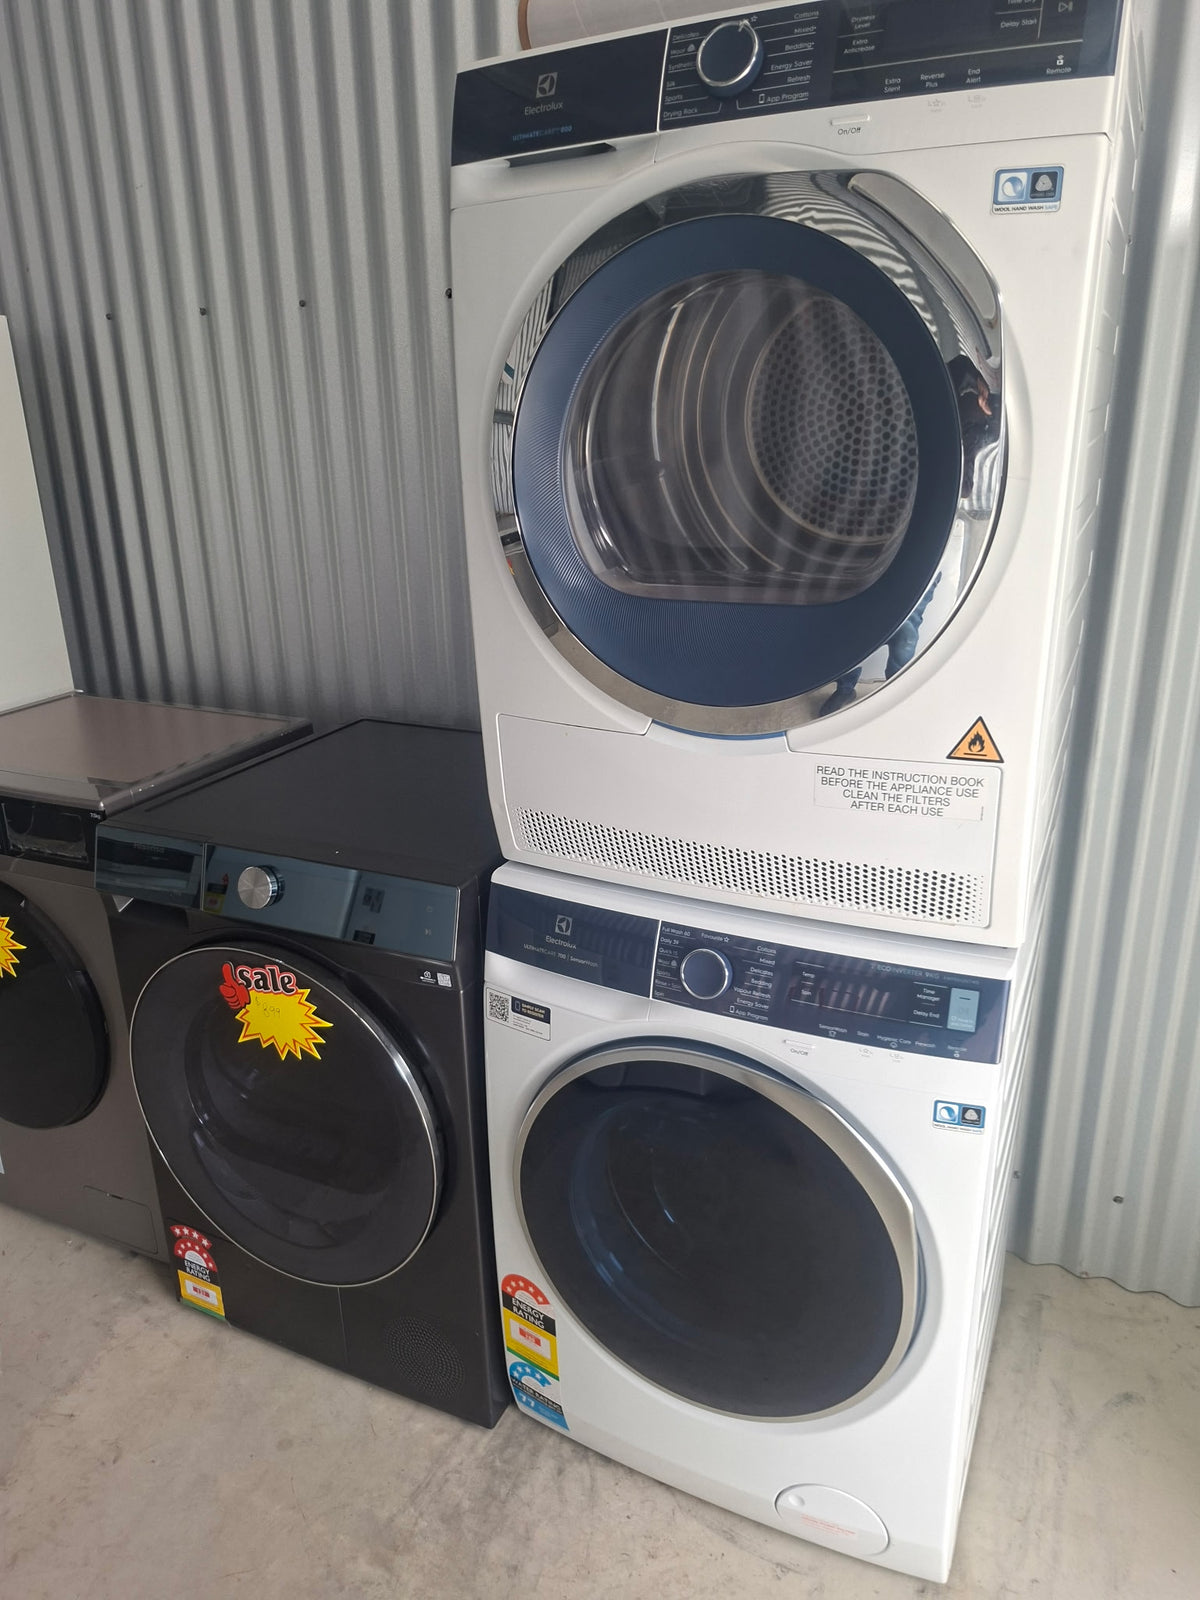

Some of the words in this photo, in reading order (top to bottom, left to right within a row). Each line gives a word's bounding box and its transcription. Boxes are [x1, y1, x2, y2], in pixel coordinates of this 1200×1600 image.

[1021, 18, 1037, 26] Start
[771, 63, 792, 72] Energy
[794, 60, 813, 68] Saver
[1046, 67, 1072, 75] Remote
[920, 72, 945, 81] Reverse
[967, 68, 981, 76] End
[885, 78, 901, 86] Extra
[966, 76, 982, 84] Alert
[884, 85, 901, 93] Silent
[766, 95, 780, 103] App
[781, 91, 809, 100] Program
[524, 101, 564, 116] Electrolux
[663, 110, 682, 118] Drying
[683, 107, 698, 115] Rack
[837, 127, 861, 136] On/Off
[816, 765, 846, 777] READ
[849, 768, 869, 779] THE
[871, 770, 948, 785] INSTRUCTION
[950, 776, 985, 788] BOOK
[821, 777, 863, 789] BEFORE
[867, 781, 888, 792] THE
[890, 783, 953, 797] APPLIANCE
[956, 788, 980, 799] USE
[843, 789, 879, 801] CLEAN
[881, 793, 903, 804] THE
[905, 794, 951, 808] FILTERS
[850, 800, 885, 813] AFTER
[887, 803, 918, 816] EACH
[921, 806, 945, 817] USE
[545, 935, 577, 950] Electrolux
[660, 936, 672, 944] Daily
[756, 945, 777, 954] Cottons
[759, 957, 776, 966] Mixed
[750, 966, 774, 977] Delicates
[237, 966, 297, 996] sale
[751, 978, 773, 989] Bedding
[733, 986, 752, 995] Vapour
[752, 990, 771, 999] Refresh
[916, 993, 940, 1002] Manager
[736, 997, 754, 1007] Energy
[754, 1001, 769, 1010] Saver
[747, 1011, 769, 1021] Program
[913, 1009, 929, 1018] Delay
[929, 1011, 940, 1019] End
[790, 1048, 809, 1056] On/Off
[184, 1260, 210, 1275] ENERGY
[186, 1266, 211, 1283] RATING
[512, 1297, 545, 1320] ENERGY
[512, 1305, 545, 1330] RATING
